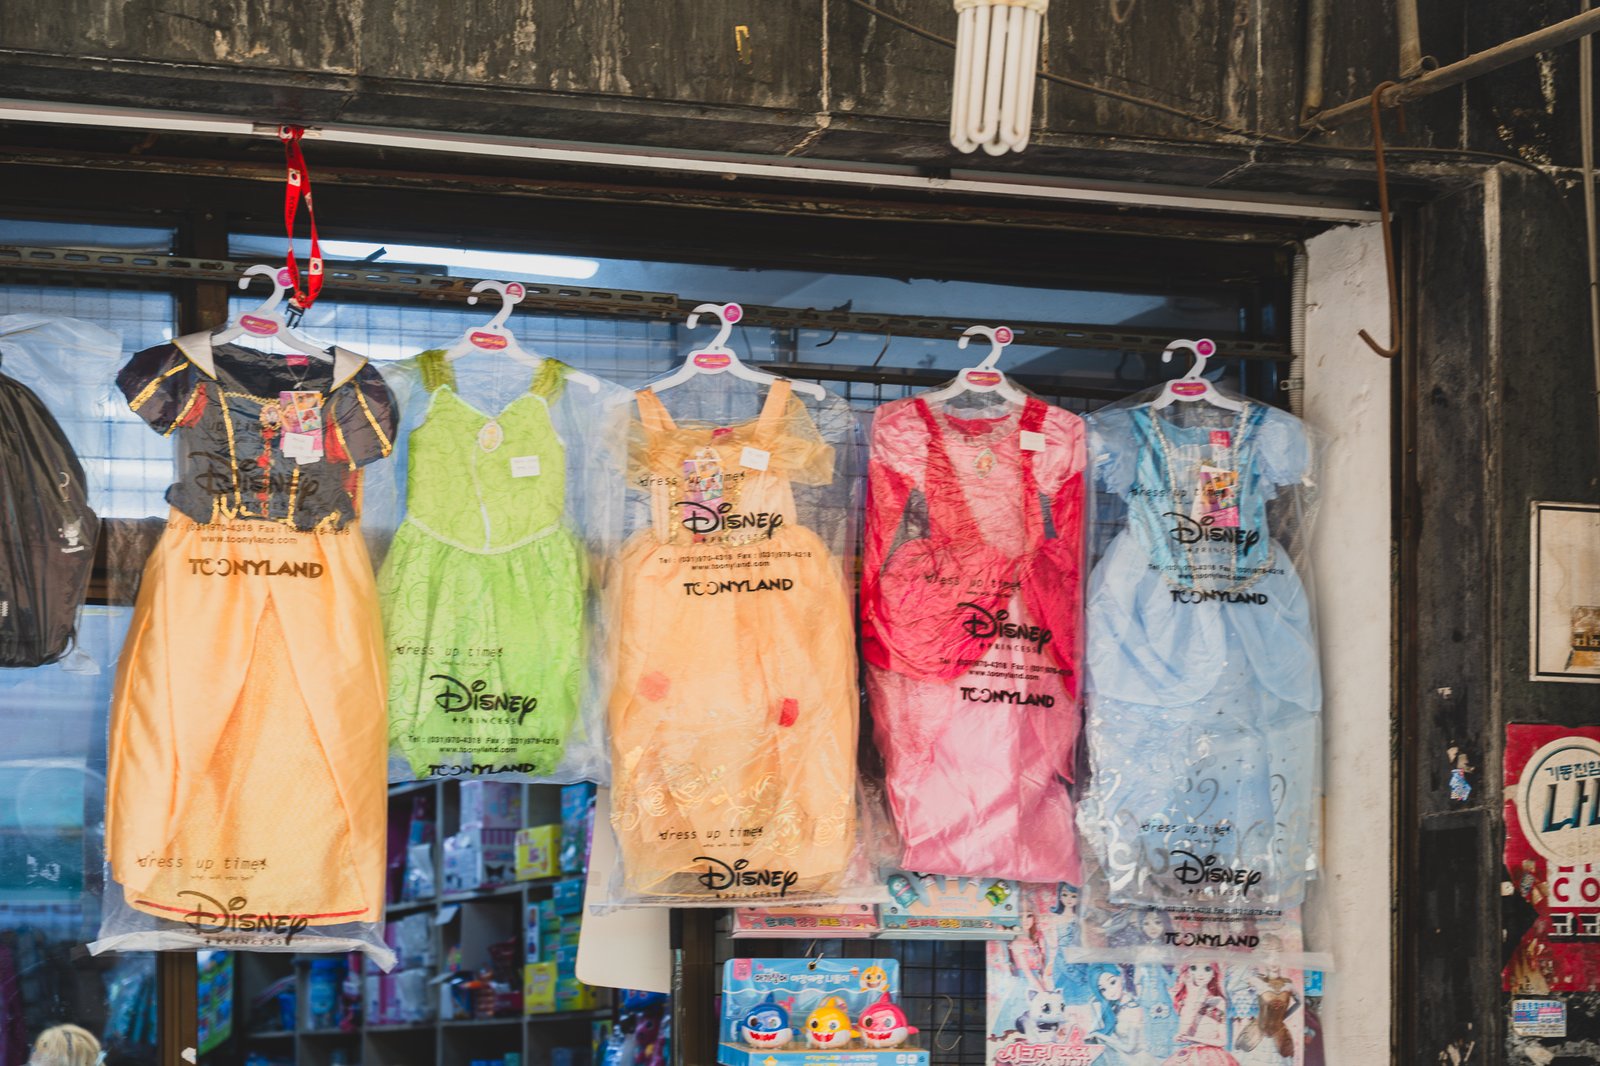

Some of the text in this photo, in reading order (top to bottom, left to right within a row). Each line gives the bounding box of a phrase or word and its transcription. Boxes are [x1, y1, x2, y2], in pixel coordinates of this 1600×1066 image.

[189, 558, 324, 579] TOONYLAND
[683, 578, 794, 596] TOONYLAND
[1170, 589, 1268, 605] TOONYLAND
[960, 687, 1055, 708] TOONYLAND
[428, 763, 537, 776] TOONYLAND
[1165, 932, 1259, 948] TOONYLAND
